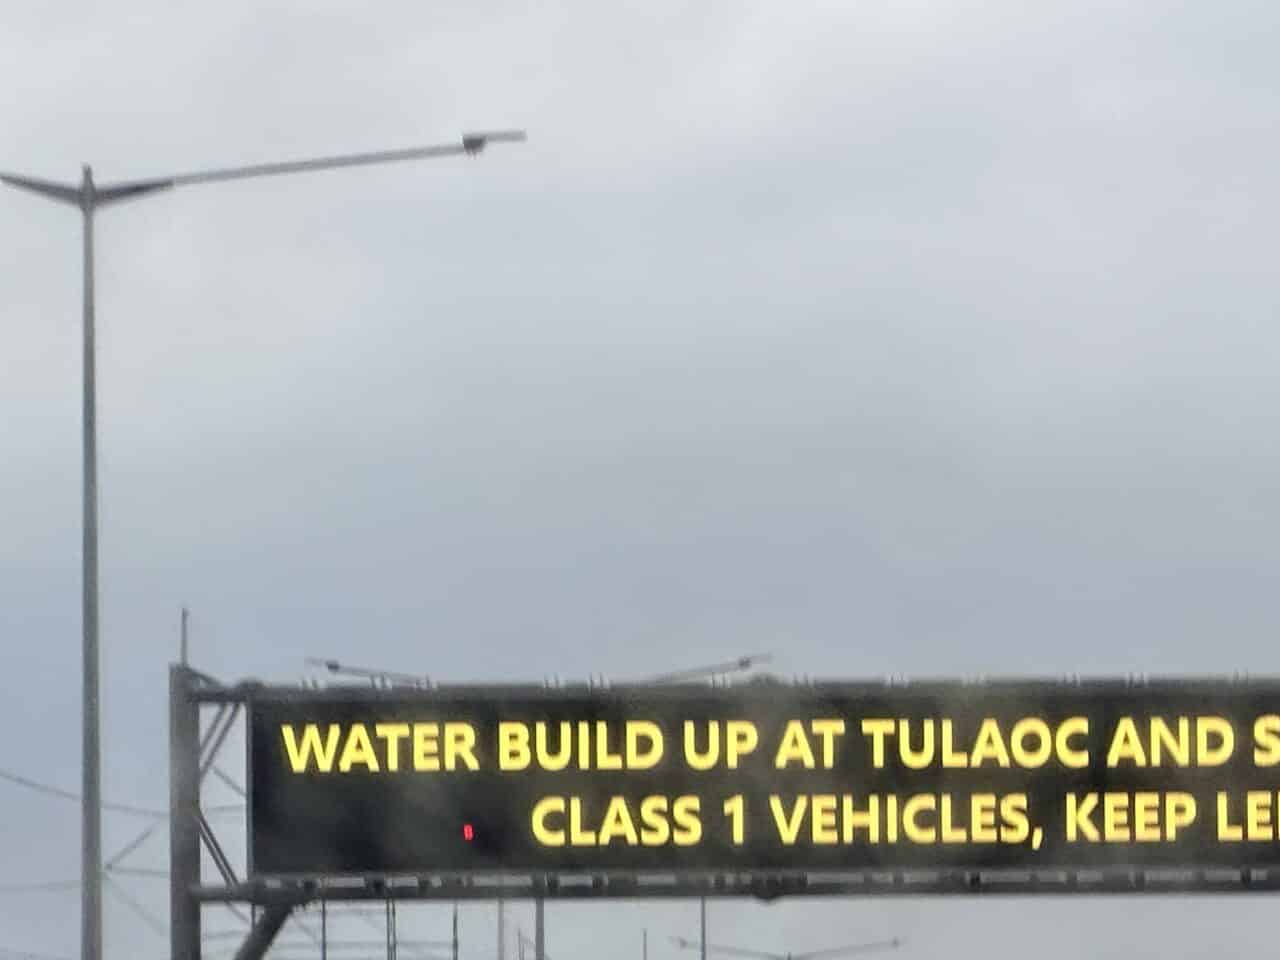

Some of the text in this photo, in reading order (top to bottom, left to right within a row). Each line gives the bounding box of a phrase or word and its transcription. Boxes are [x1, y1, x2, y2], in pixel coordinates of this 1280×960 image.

[281, 720, 481, 773] WATER
[498, 719, 664, 771] BUILD
[683, 719, 760, 770] UP
[773, 718, 845, 769] AT
[861, 716, 1089, 769] TULAOC
[1106, 715, 1234, 767] AND
[531, 795, 702, 846] CLASS
[723, 793, 744, 844] 1
[768, 792, 1042, 849] VEHICLES,
[1065, 791, 1196, 842] KEEP
